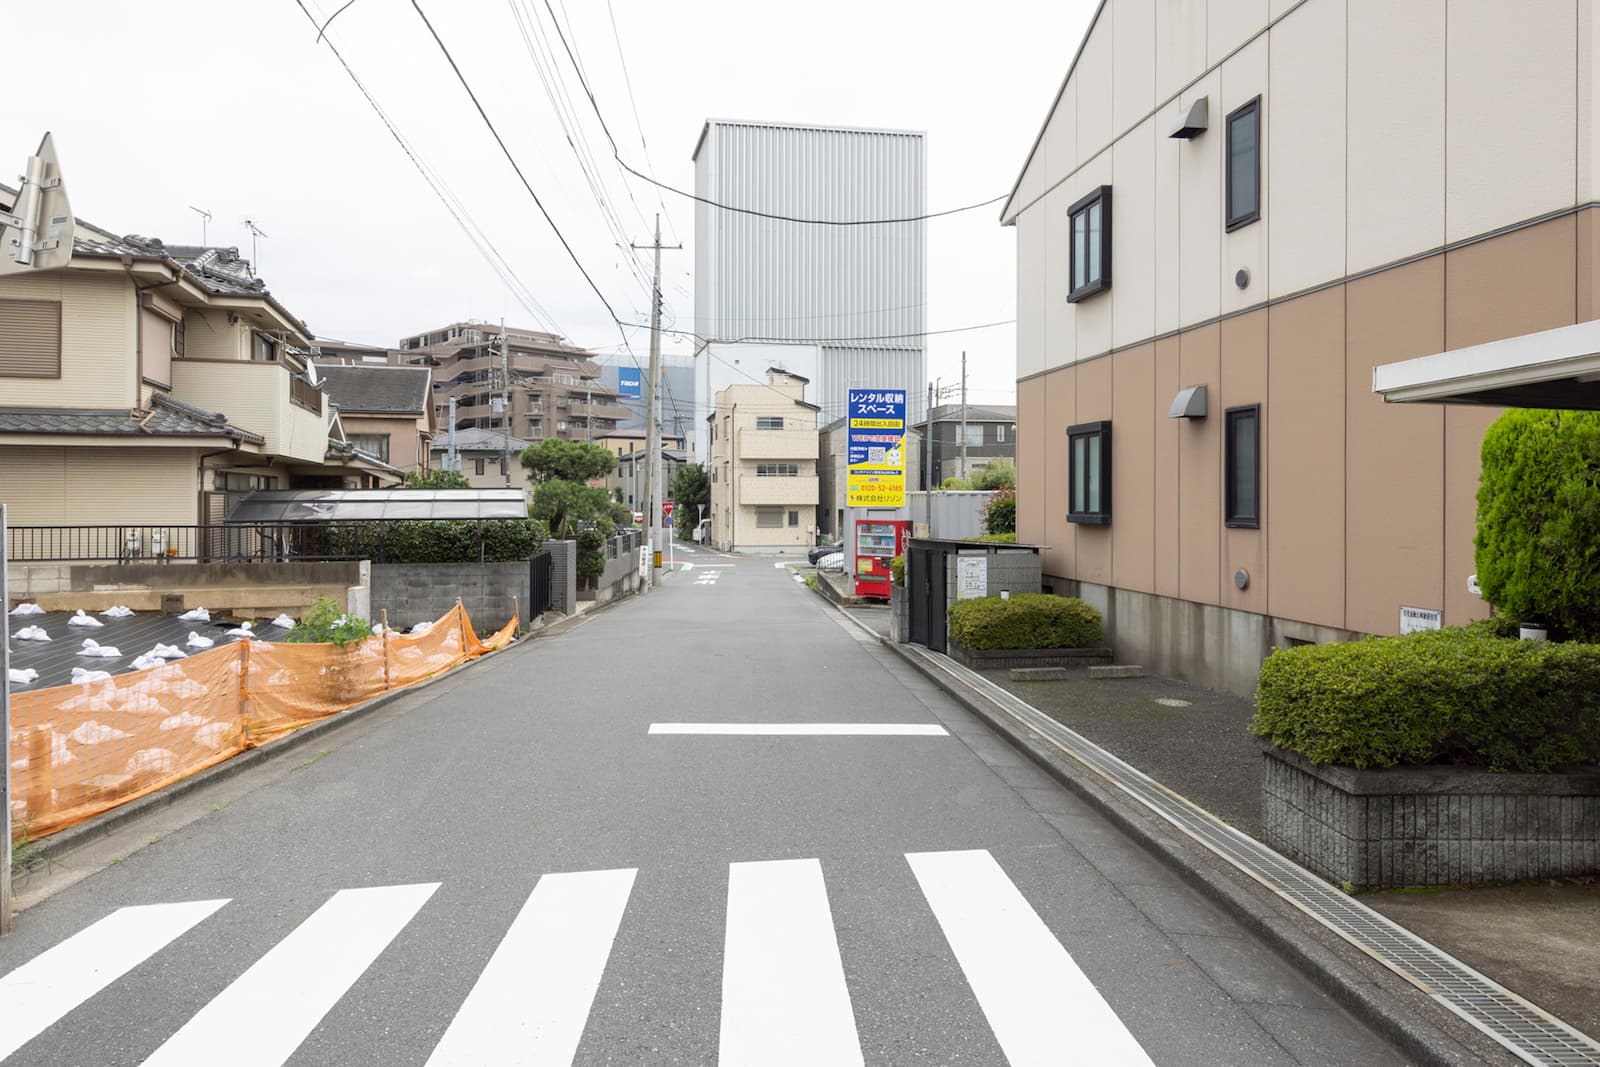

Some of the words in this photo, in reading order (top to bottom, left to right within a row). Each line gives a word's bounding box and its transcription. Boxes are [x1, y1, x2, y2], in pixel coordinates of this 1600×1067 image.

[851, 393, 903, 404] レンタル収納
[858, 404, 895, 414] スペース
